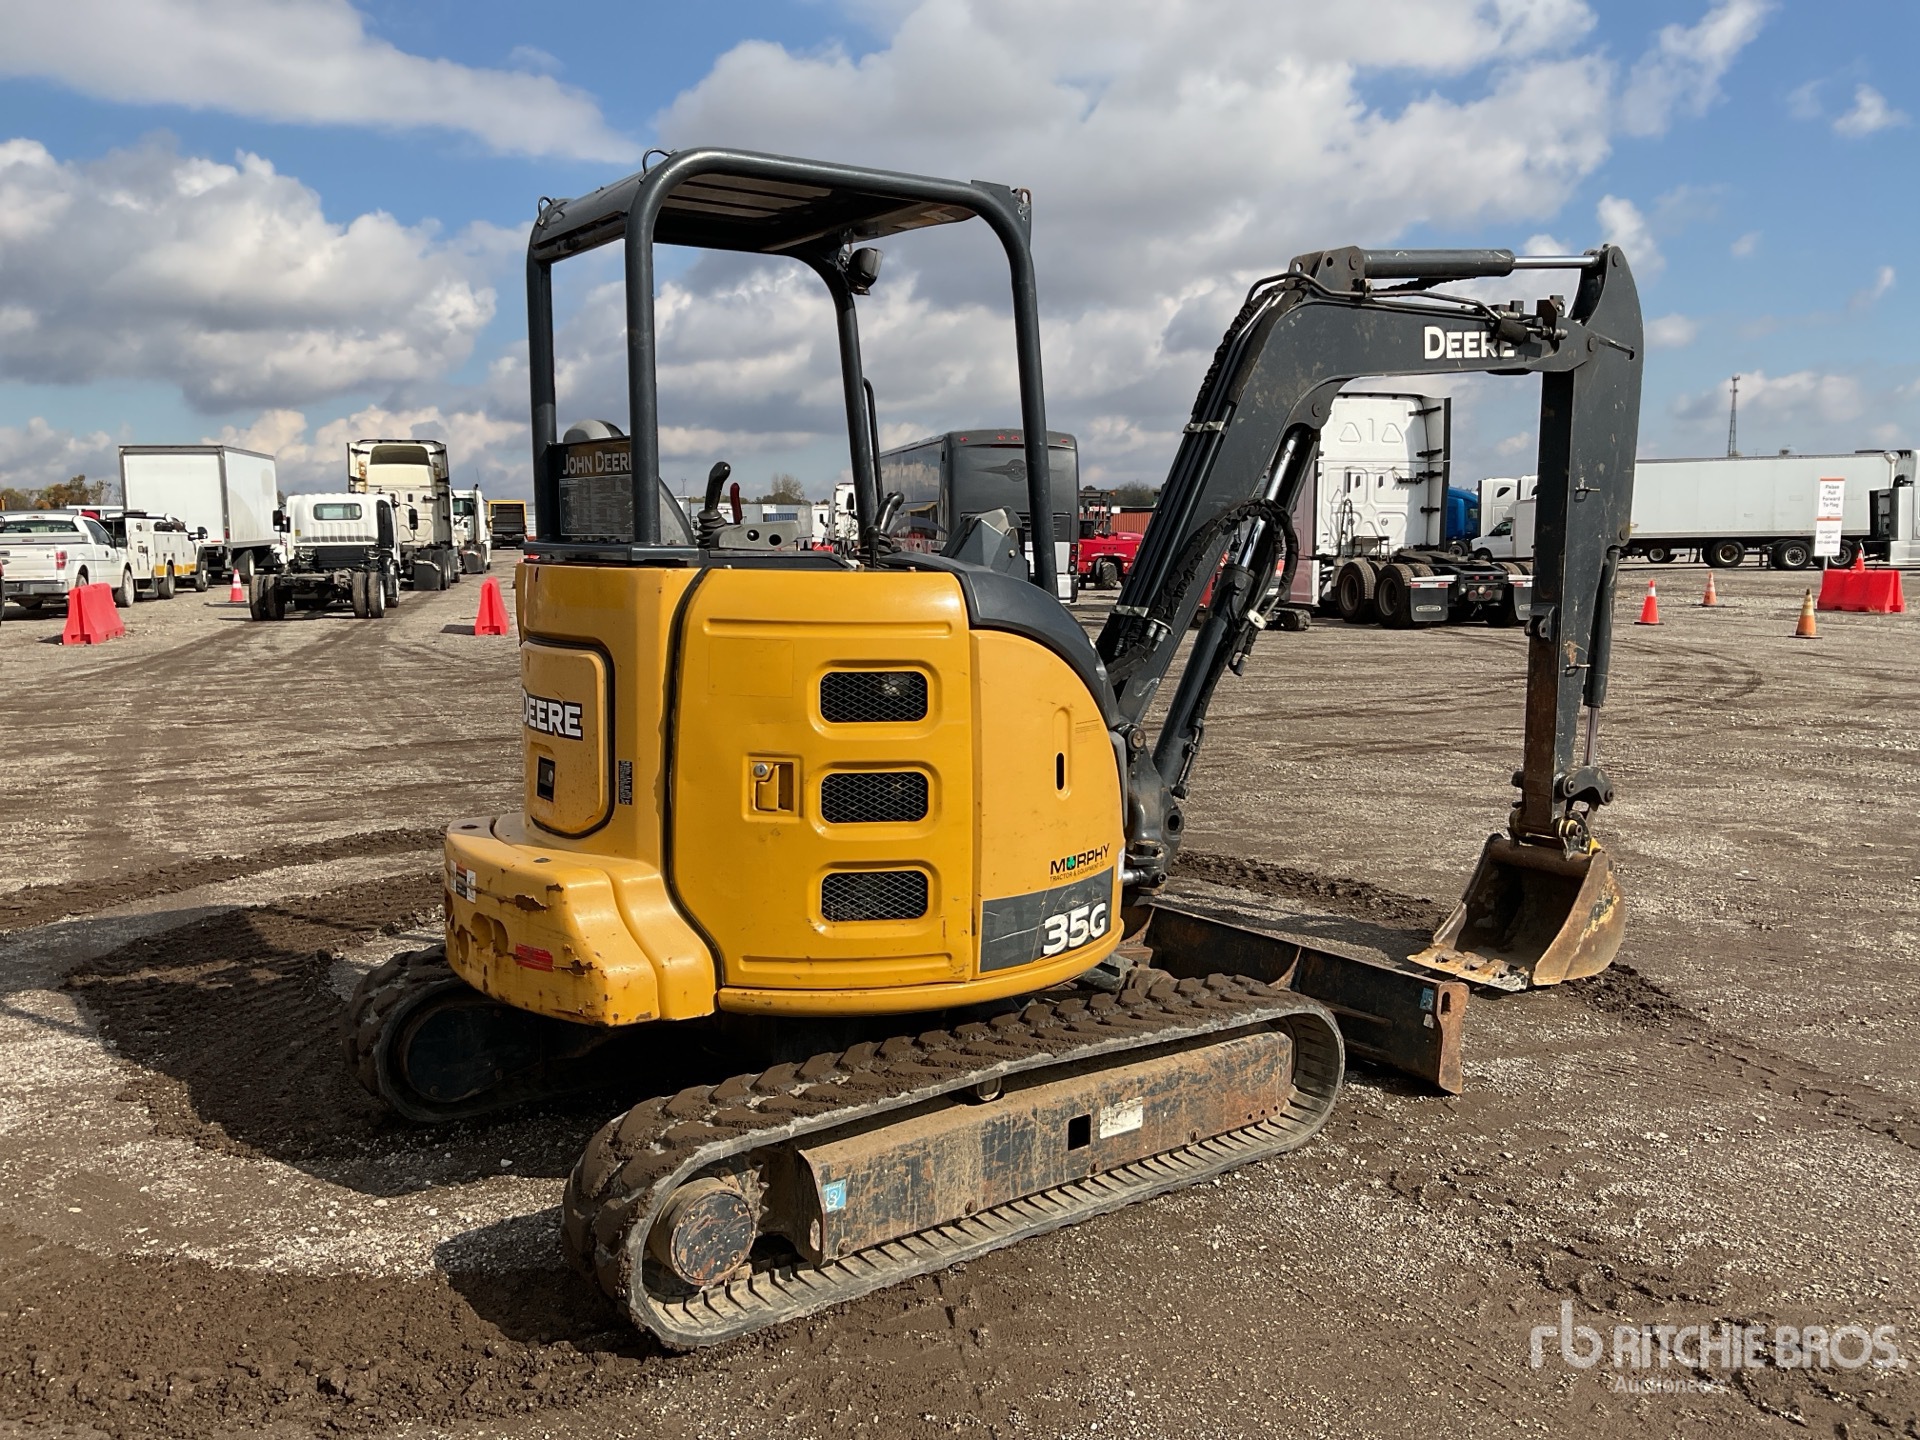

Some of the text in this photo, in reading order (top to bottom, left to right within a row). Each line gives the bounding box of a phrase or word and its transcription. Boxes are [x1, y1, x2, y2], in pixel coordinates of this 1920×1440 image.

[562, 453, 593, 475] JOHN
[522, 686, 582, 738] DEERE
[1050, 842, 1111, 875] MURPHY
[1050, 871, 1073, 882] TRACTOR
[1043, 902, 1107, 955] 35G
